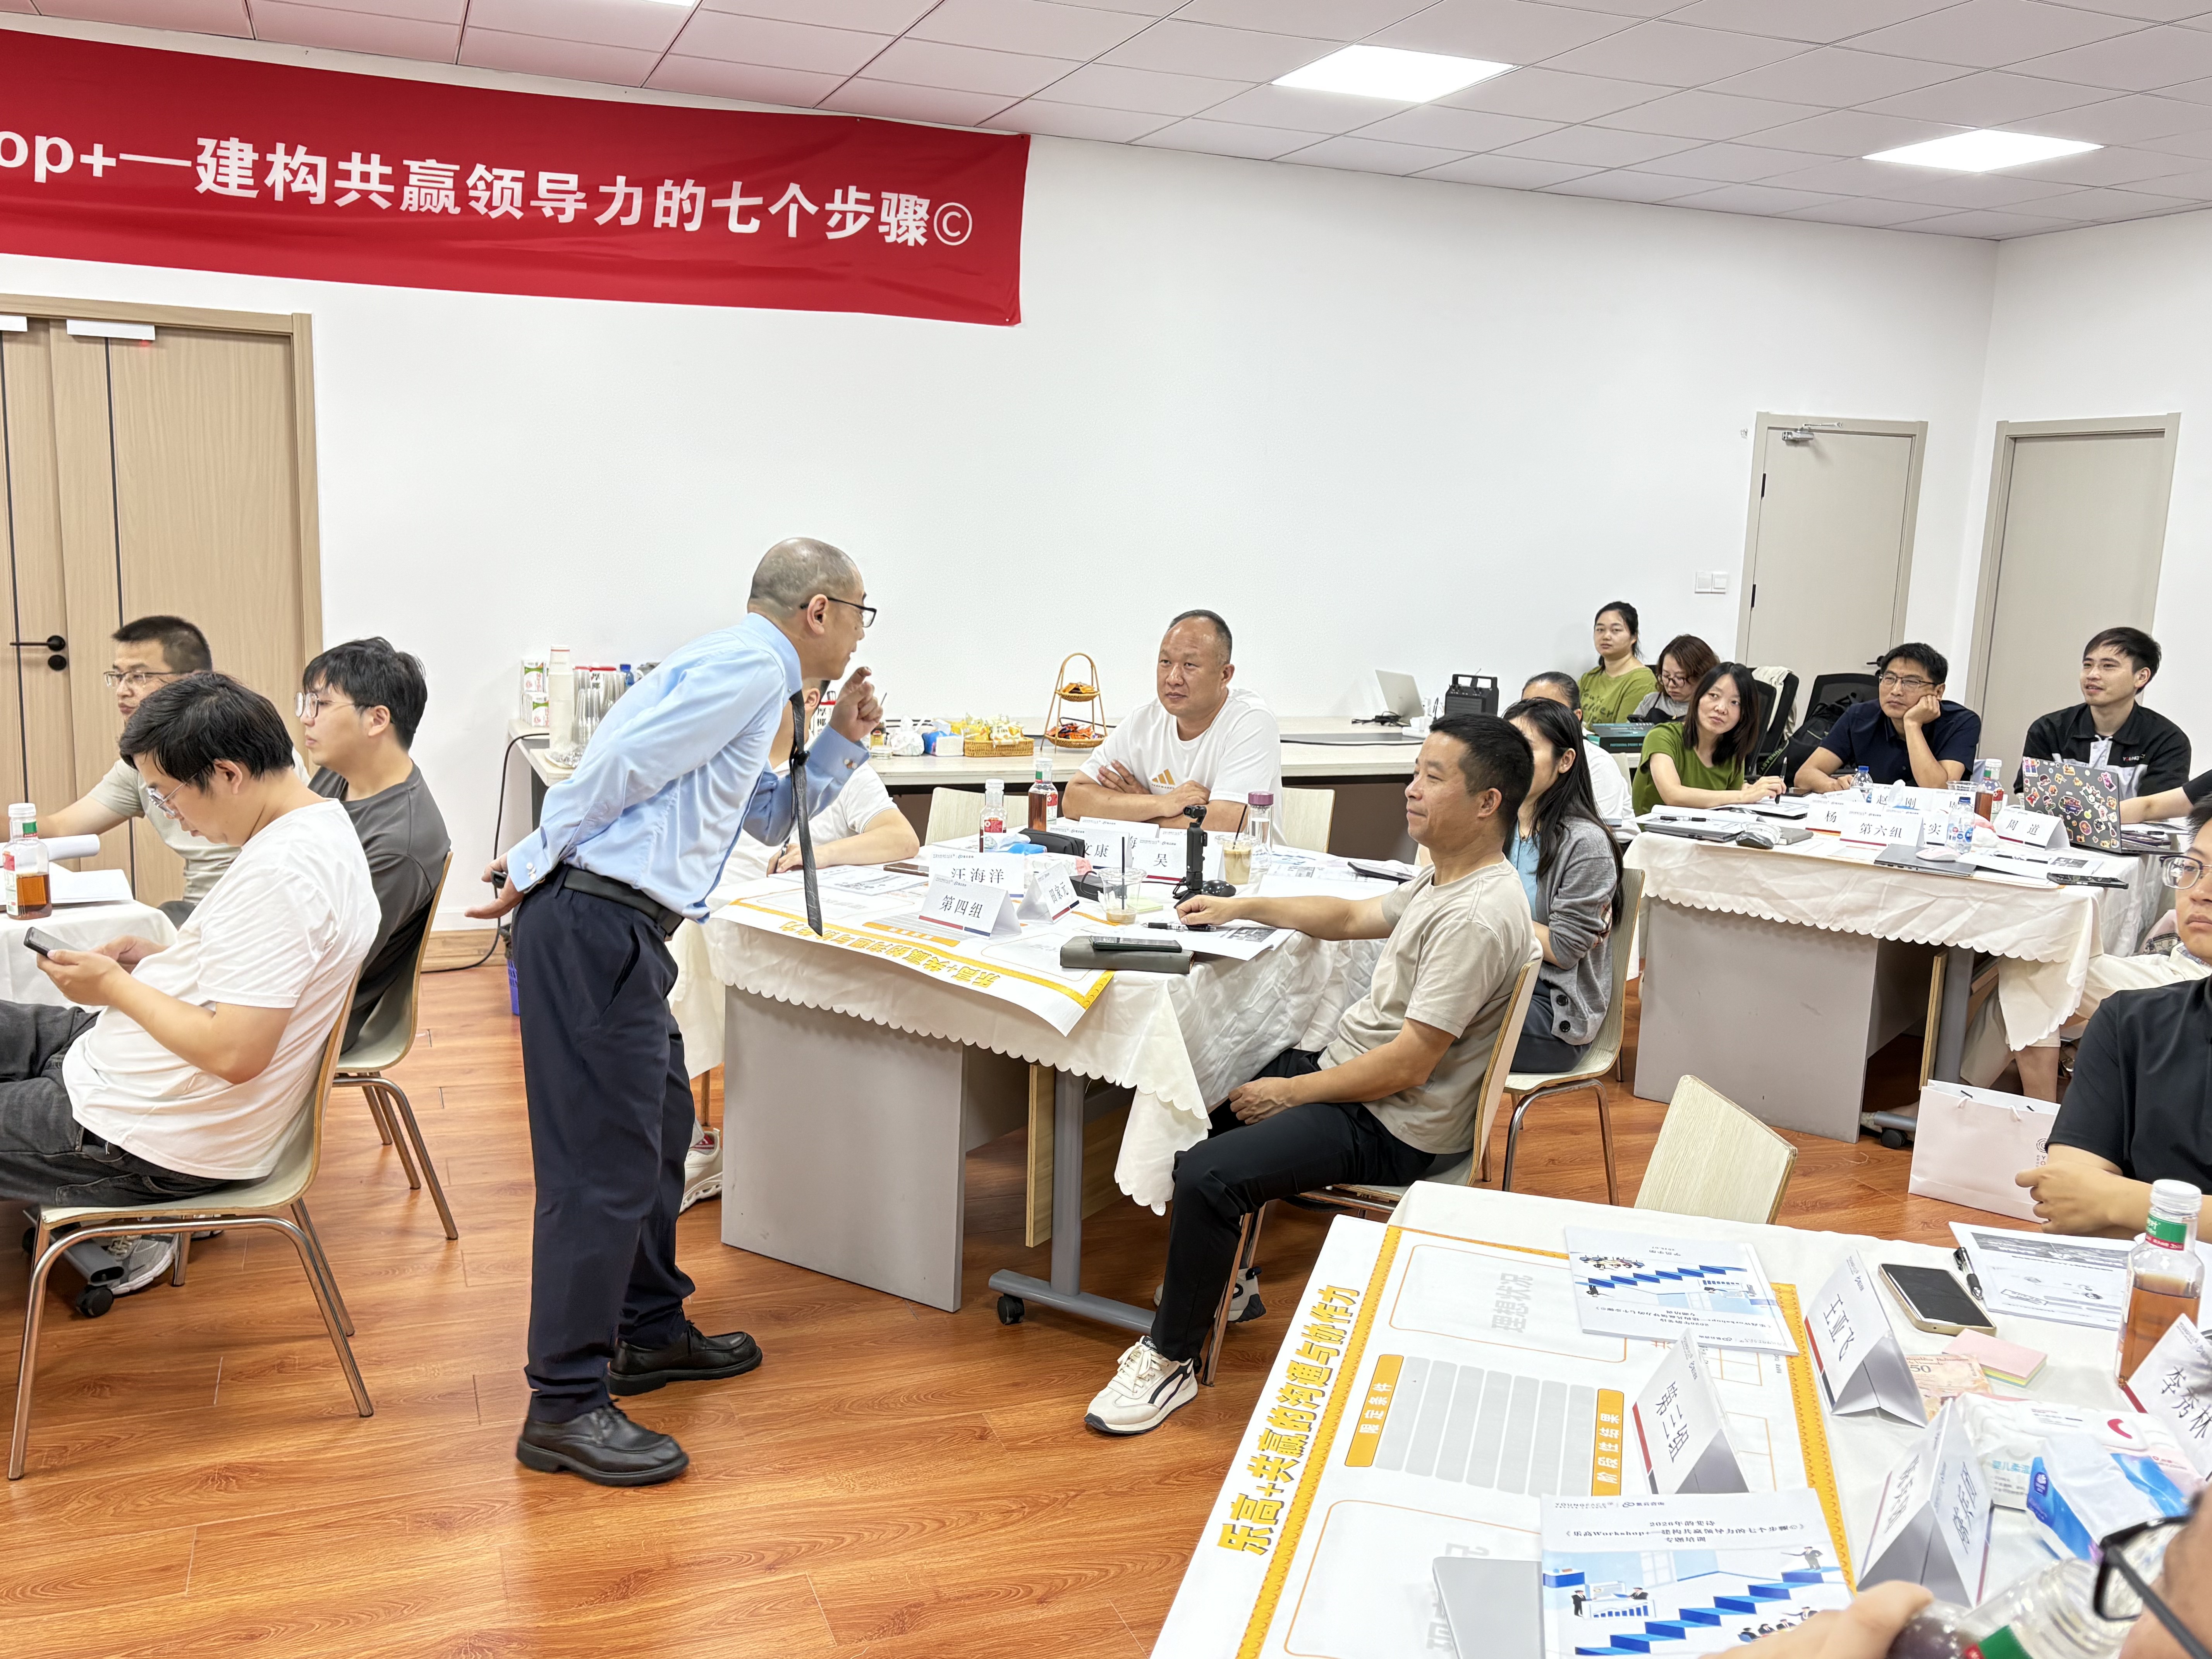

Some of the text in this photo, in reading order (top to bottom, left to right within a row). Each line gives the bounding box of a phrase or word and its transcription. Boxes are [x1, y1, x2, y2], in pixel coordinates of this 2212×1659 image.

[1859, 823, 1902, 838] 第六组
[939, 895, 983, 919] 第四组
[1490, 1272, 1534, 1334] 理想状况
[1823, 1293, 1855, 1362] 王亚飞
[1216, 1284, 1361, 1557] 乐高+共赢的沟通与协作力
[1358, 1381, 1394, 1435] 限定条件
[1656, 1379, 1689, 1464] 第三组
[1595, 1412, 1621, 1485] 阶段性结果
